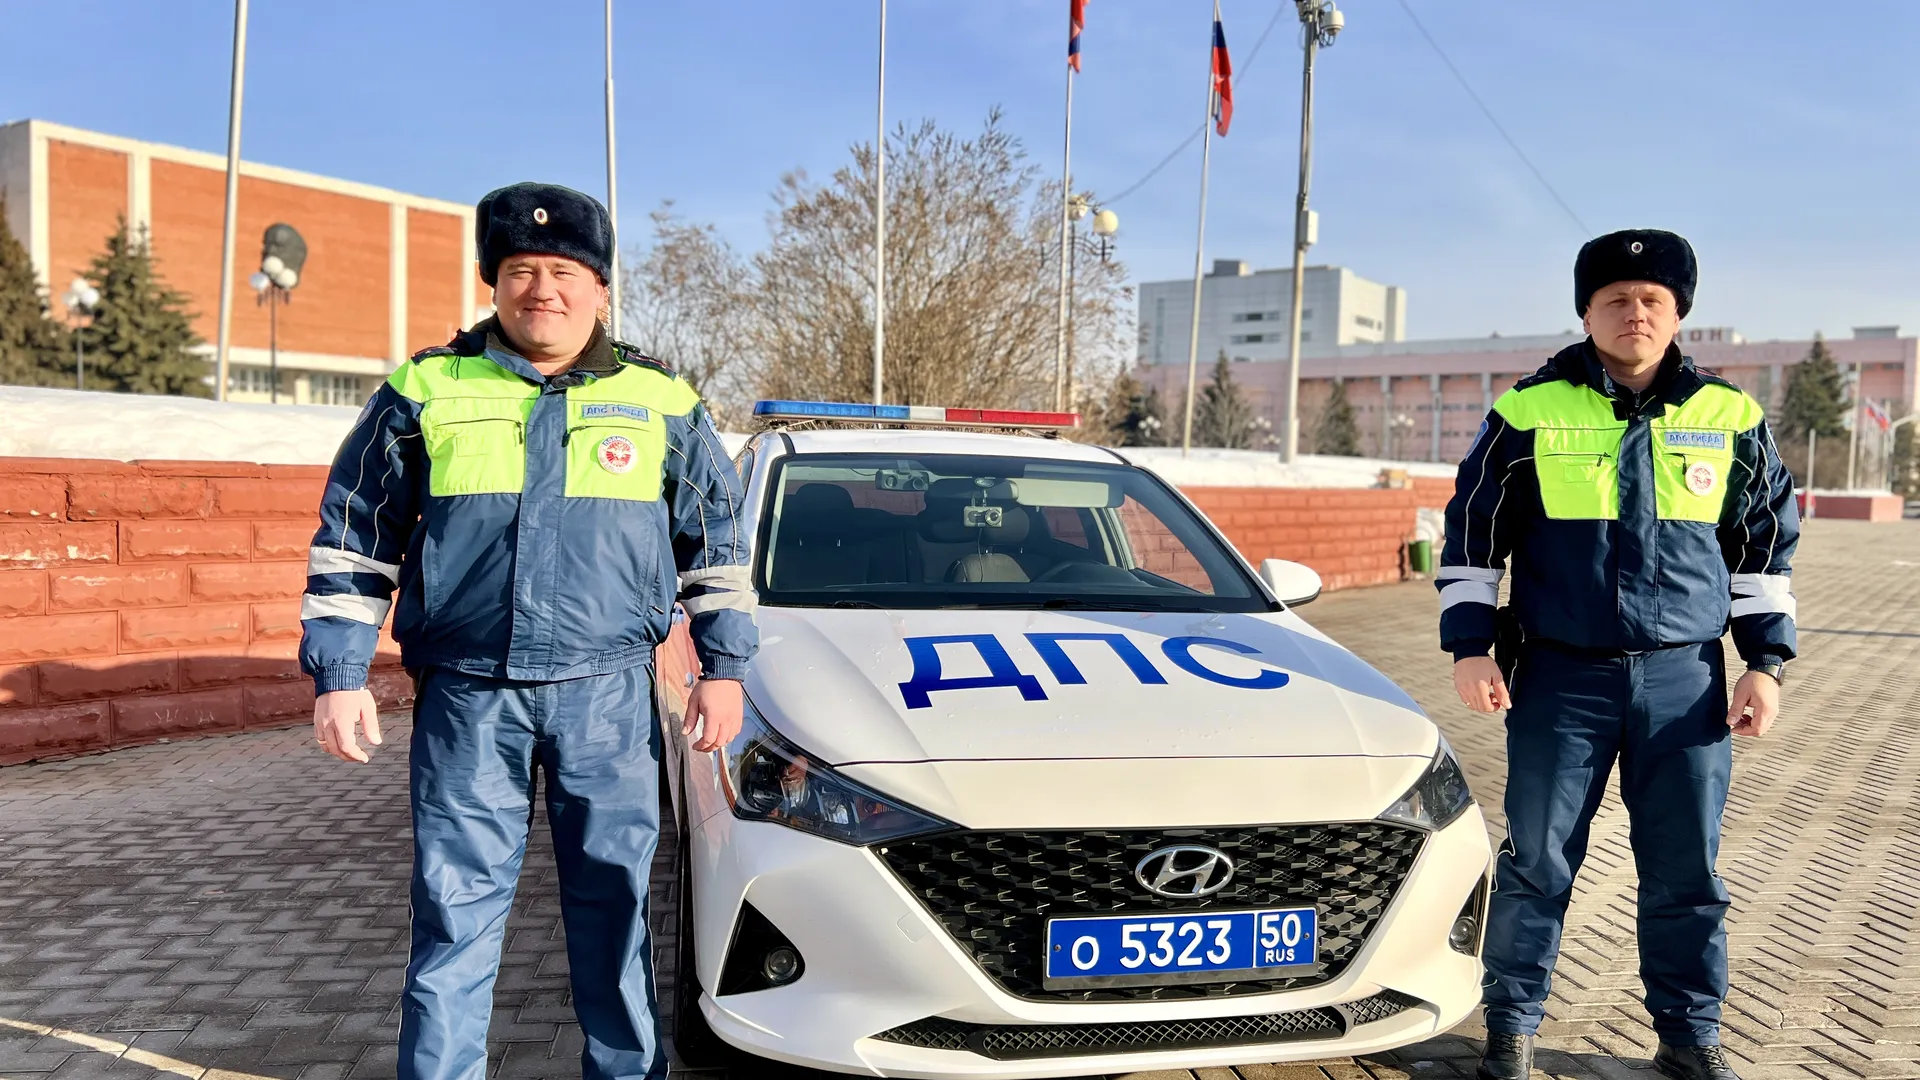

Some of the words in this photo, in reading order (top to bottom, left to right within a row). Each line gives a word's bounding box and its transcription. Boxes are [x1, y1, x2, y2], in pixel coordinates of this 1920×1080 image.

[587, 406, 607, 416] ДПС
[1669, 434, 1688, 442] ДПС
[897, 632, 1290, 710] ДПС
[1071, 935, 1100, 971] О
[1119, 919, 1232, 969] 5323
[1260, 913, 1301, 949] 50
[1264, 948, 1296, 963] RUS
